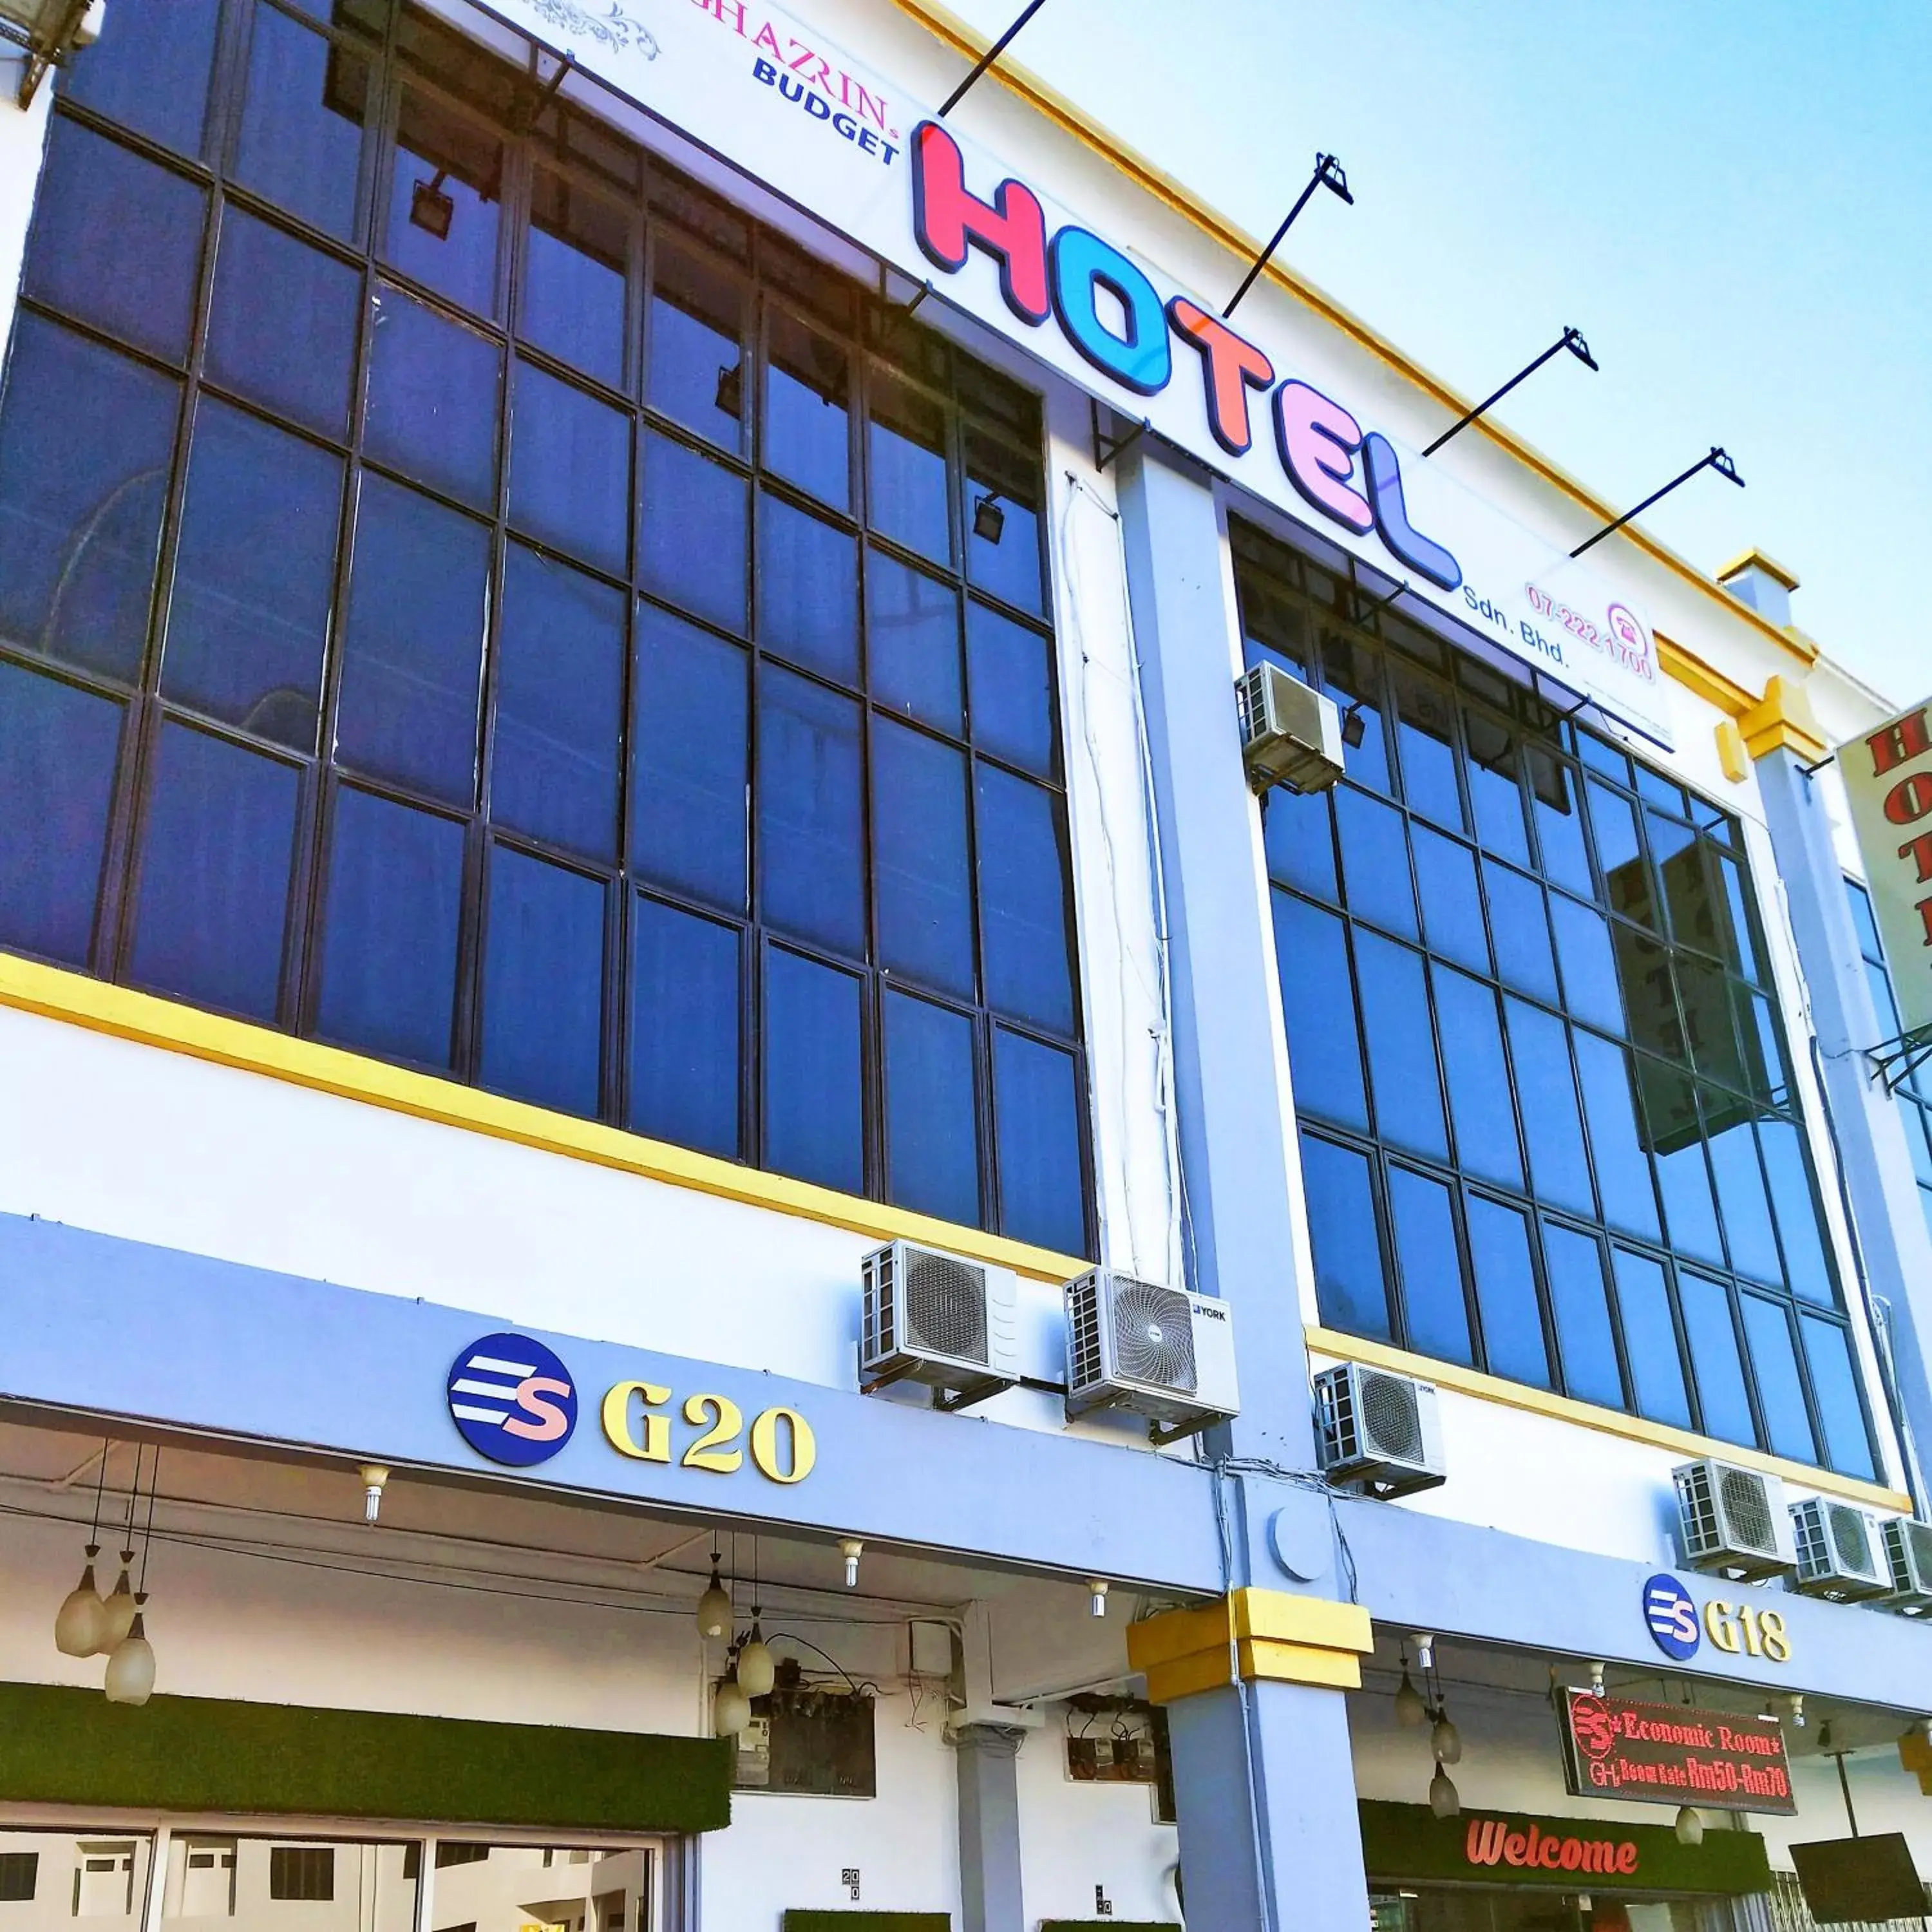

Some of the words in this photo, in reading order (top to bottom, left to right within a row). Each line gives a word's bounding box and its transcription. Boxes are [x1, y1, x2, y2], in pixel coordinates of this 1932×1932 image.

[752, 57, 900, 166] BUDGET
[911, 120, 1463, 592] HOTEL
[1463, 585, 1514, 635] Sdn.
[1520, 620, 1570, 668] Bhd.
[1200, 1305, 1226, 1322] YORK
[600, 1379, 817, 1484] G20
[1704, 1599, 1792, 1662] G18
[1622, 1710, 1715, 1749] Economic
[1716, 1726, 1773, 1756] Room
[1620, 1758, 1658, 1783] Room
[842, 1869, 859, 1883] 20
[1465, 1819, 1640, 1875] Welcome
